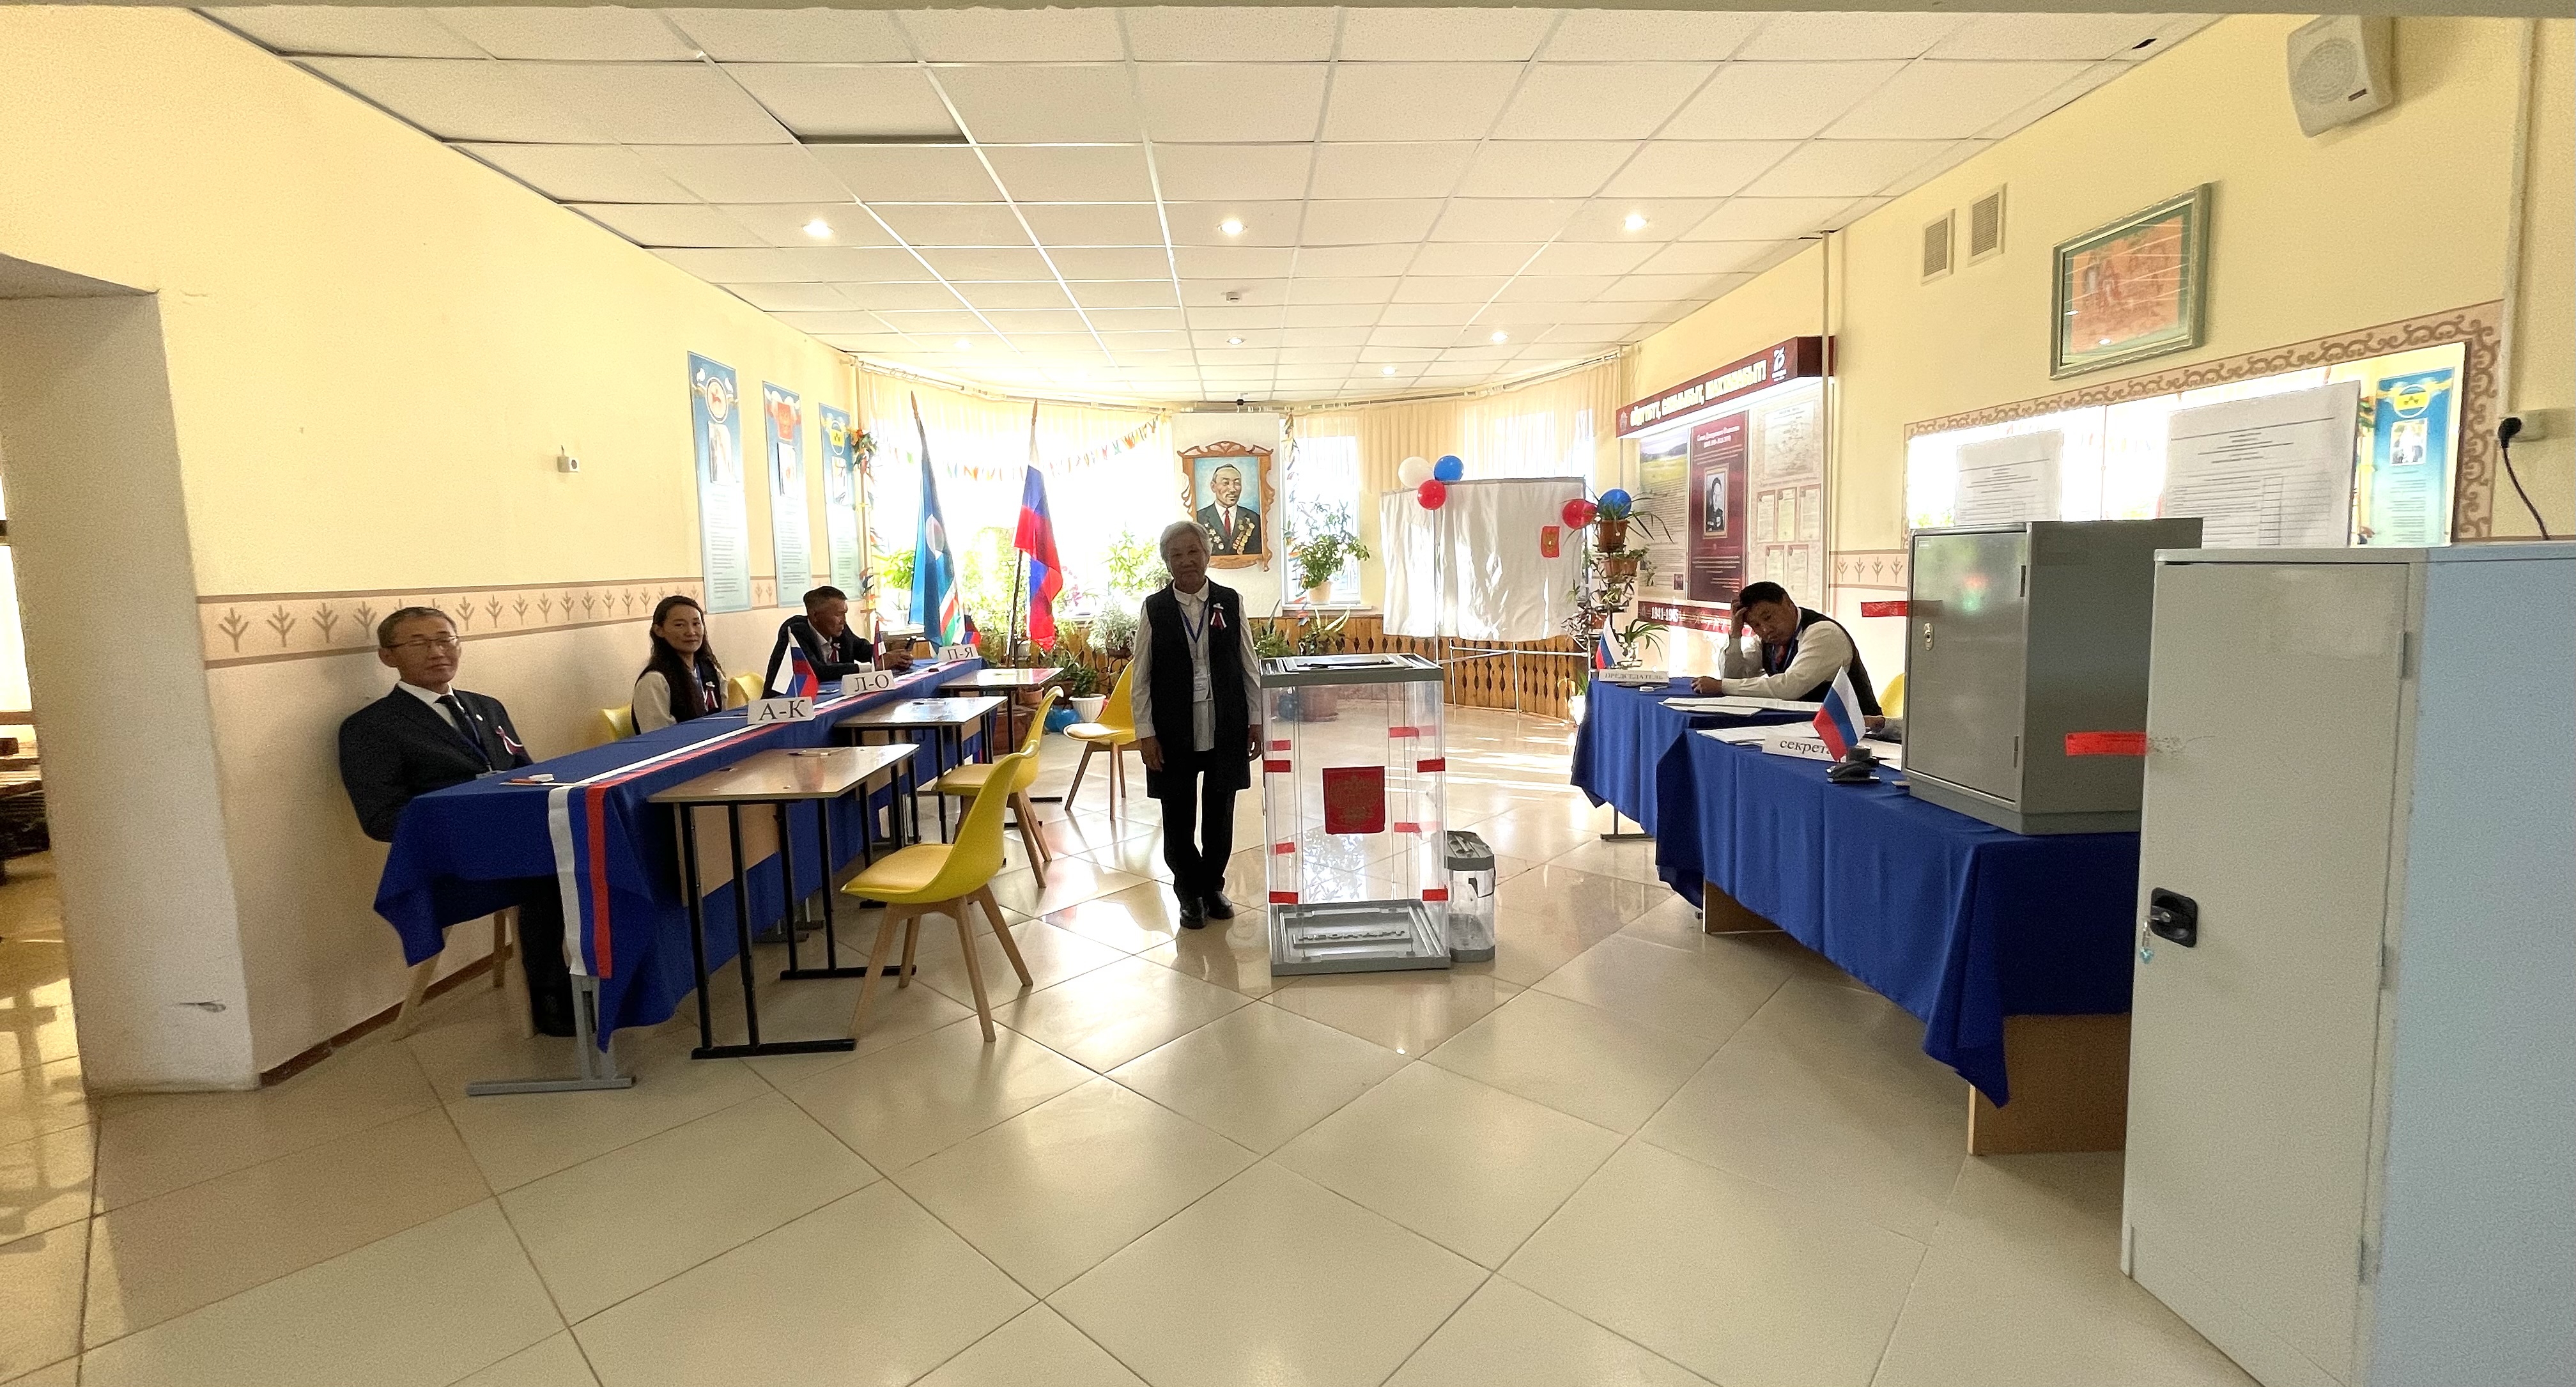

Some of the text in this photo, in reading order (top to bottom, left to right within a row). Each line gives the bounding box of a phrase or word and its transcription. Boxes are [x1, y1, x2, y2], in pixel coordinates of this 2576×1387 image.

[947, 646, 973, 660] П-Я
[854, 674, 889, 692] Л-О
[758, 700, 806, 721] А-К
